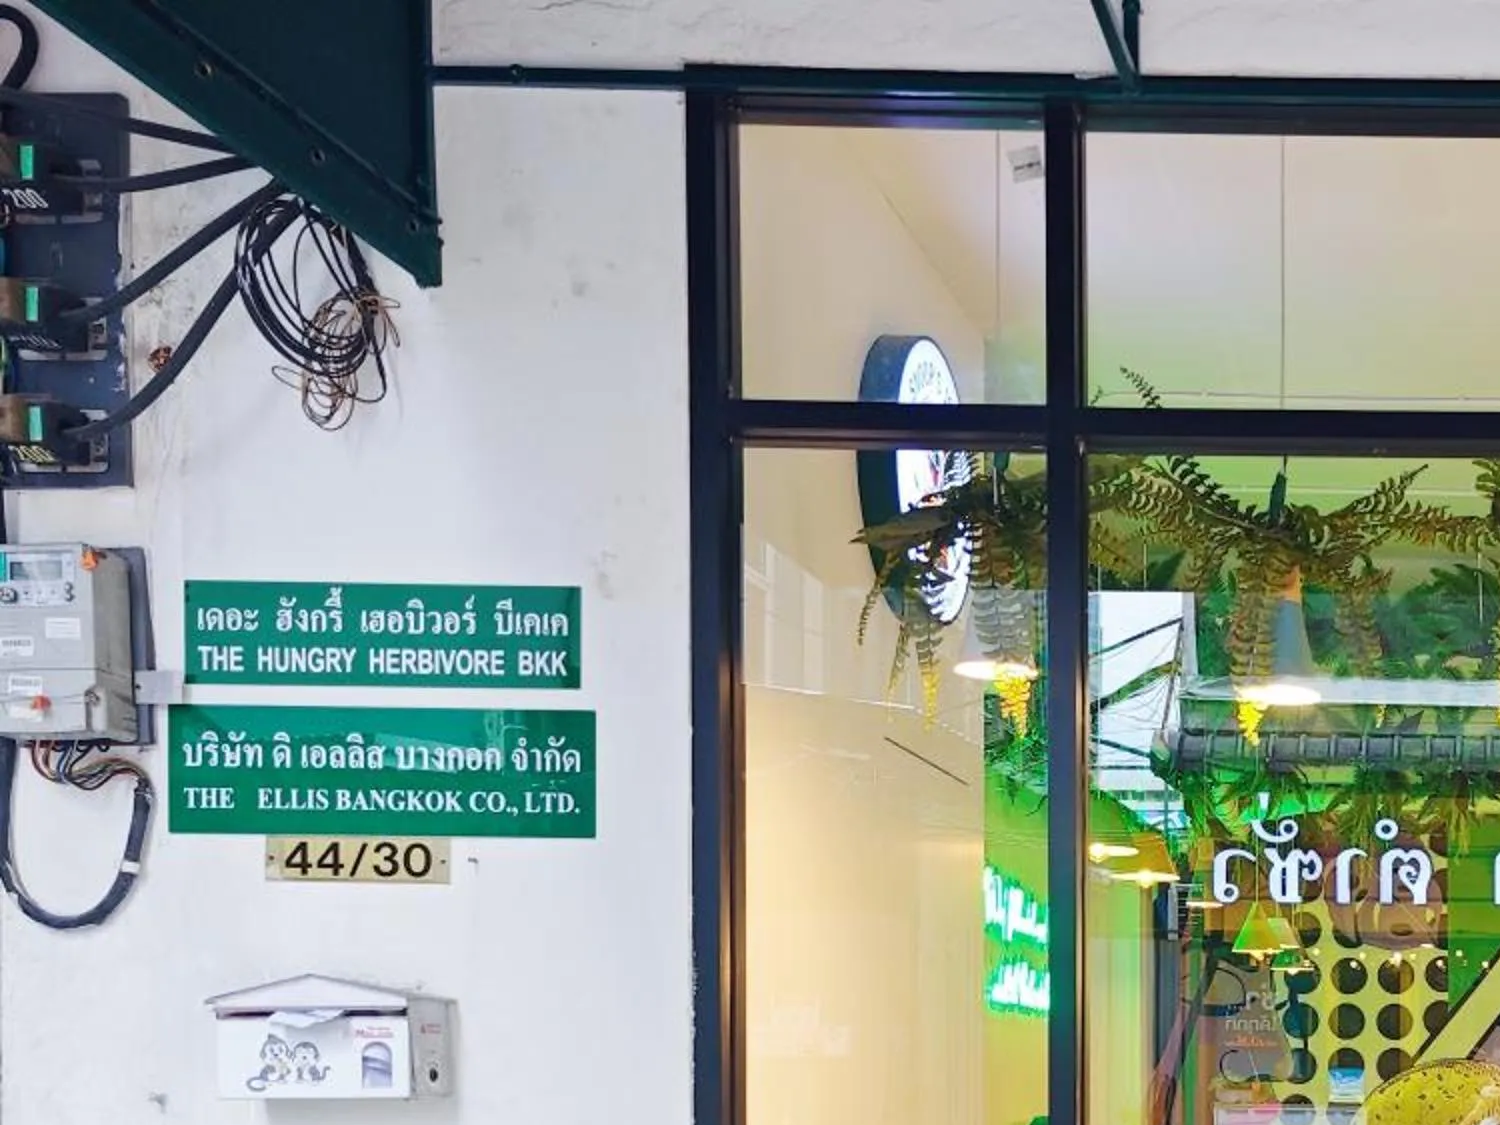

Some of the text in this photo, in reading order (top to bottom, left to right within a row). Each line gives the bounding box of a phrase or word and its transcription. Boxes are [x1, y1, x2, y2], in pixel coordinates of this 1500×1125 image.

[197, 607, 259, 631] เดอะ
[360, 594, 477, 636] เฮอบิวอร์
[493, 597, 569, 637] บีเคเค
[197, 645, 568, 677] THE HUNGRY HERBIVORE BKK
[182, 731, 581, 773] บริษัท ดิ เอลลิส บางกอก จำกัด
[183, 787, 581, 817] THE ELLIS BANGKOK CO., LTD.
[284, 841, 433, 878] 44/30
